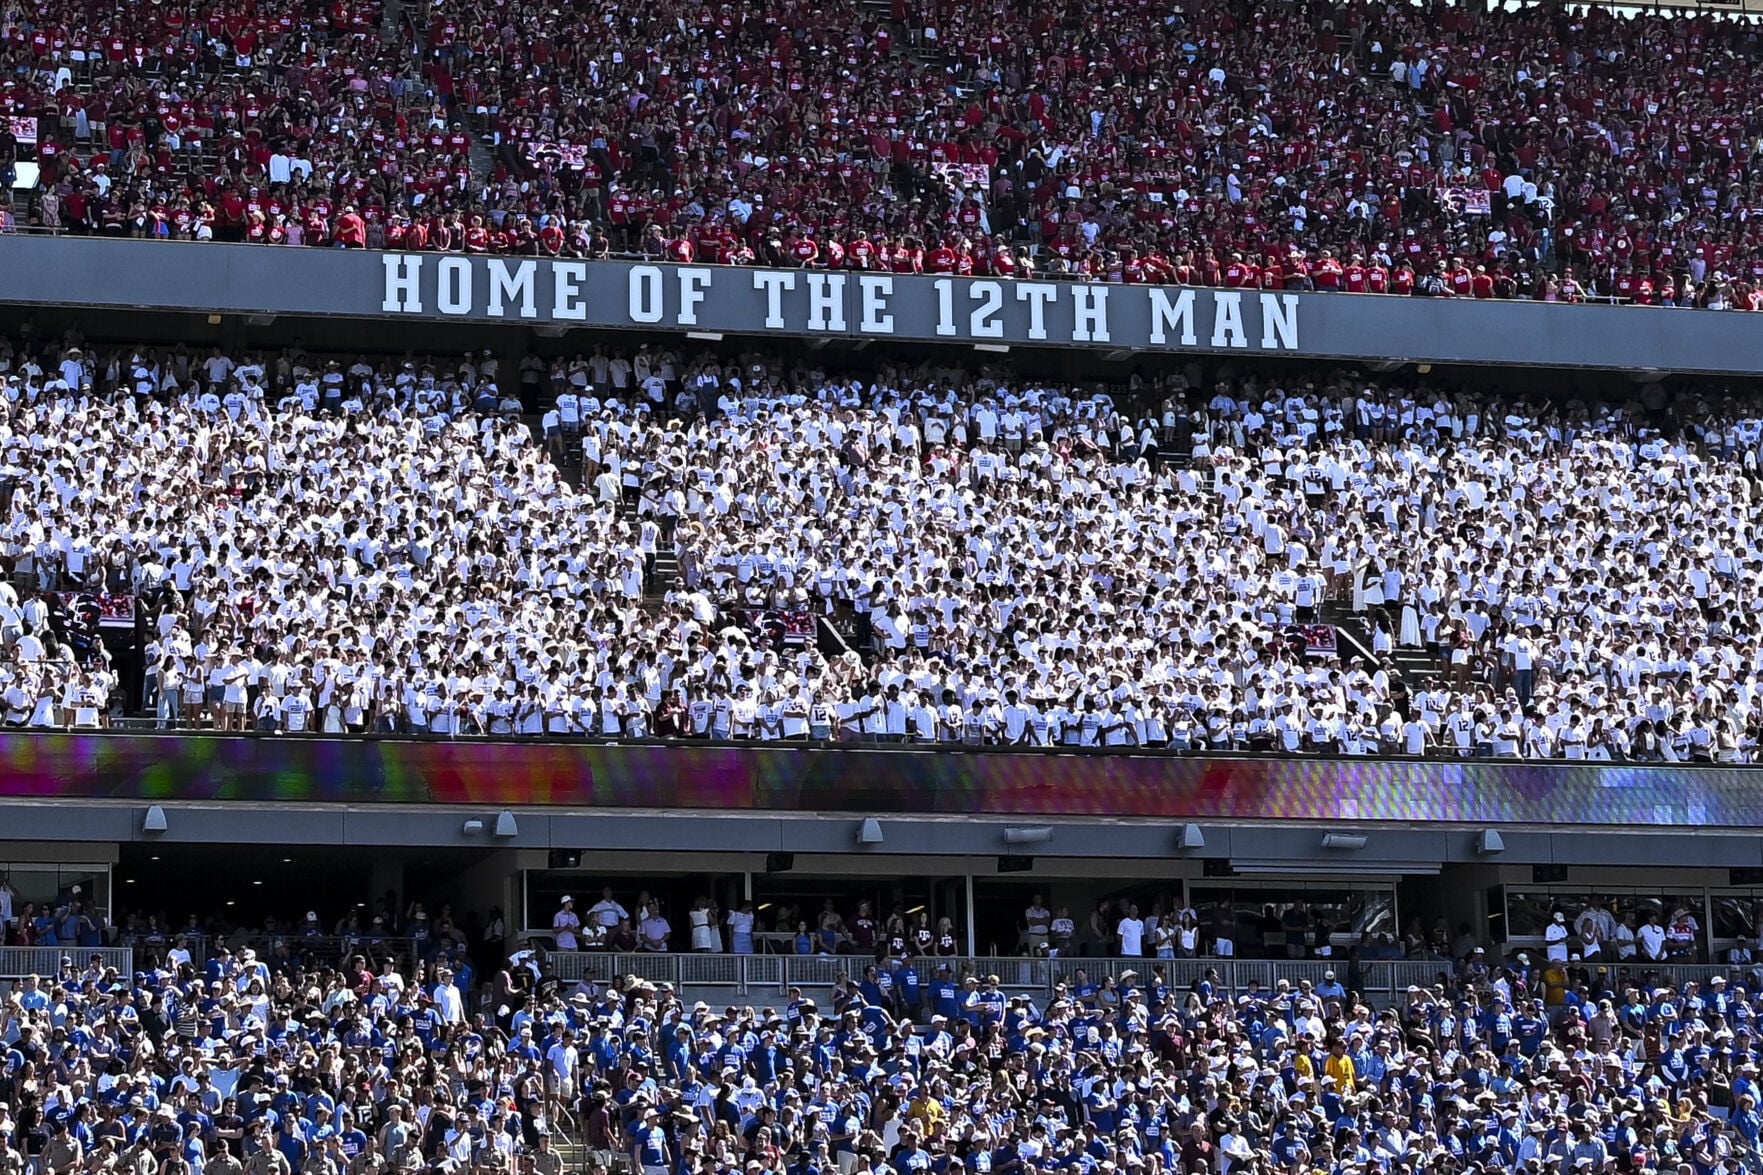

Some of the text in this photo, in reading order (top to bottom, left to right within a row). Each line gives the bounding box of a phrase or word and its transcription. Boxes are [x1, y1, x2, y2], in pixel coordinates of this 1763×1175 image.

[383, 255, 1299, 349] HOME OF THE 12TH MAN
[1309, 471, 1321, 480] 12
[814, 710, 827, 721] 12
[1458, 720, 1469, 732] 12
[1346, 731, 1357, 742] 12
[989, 1045, 1002, 1059] 12
